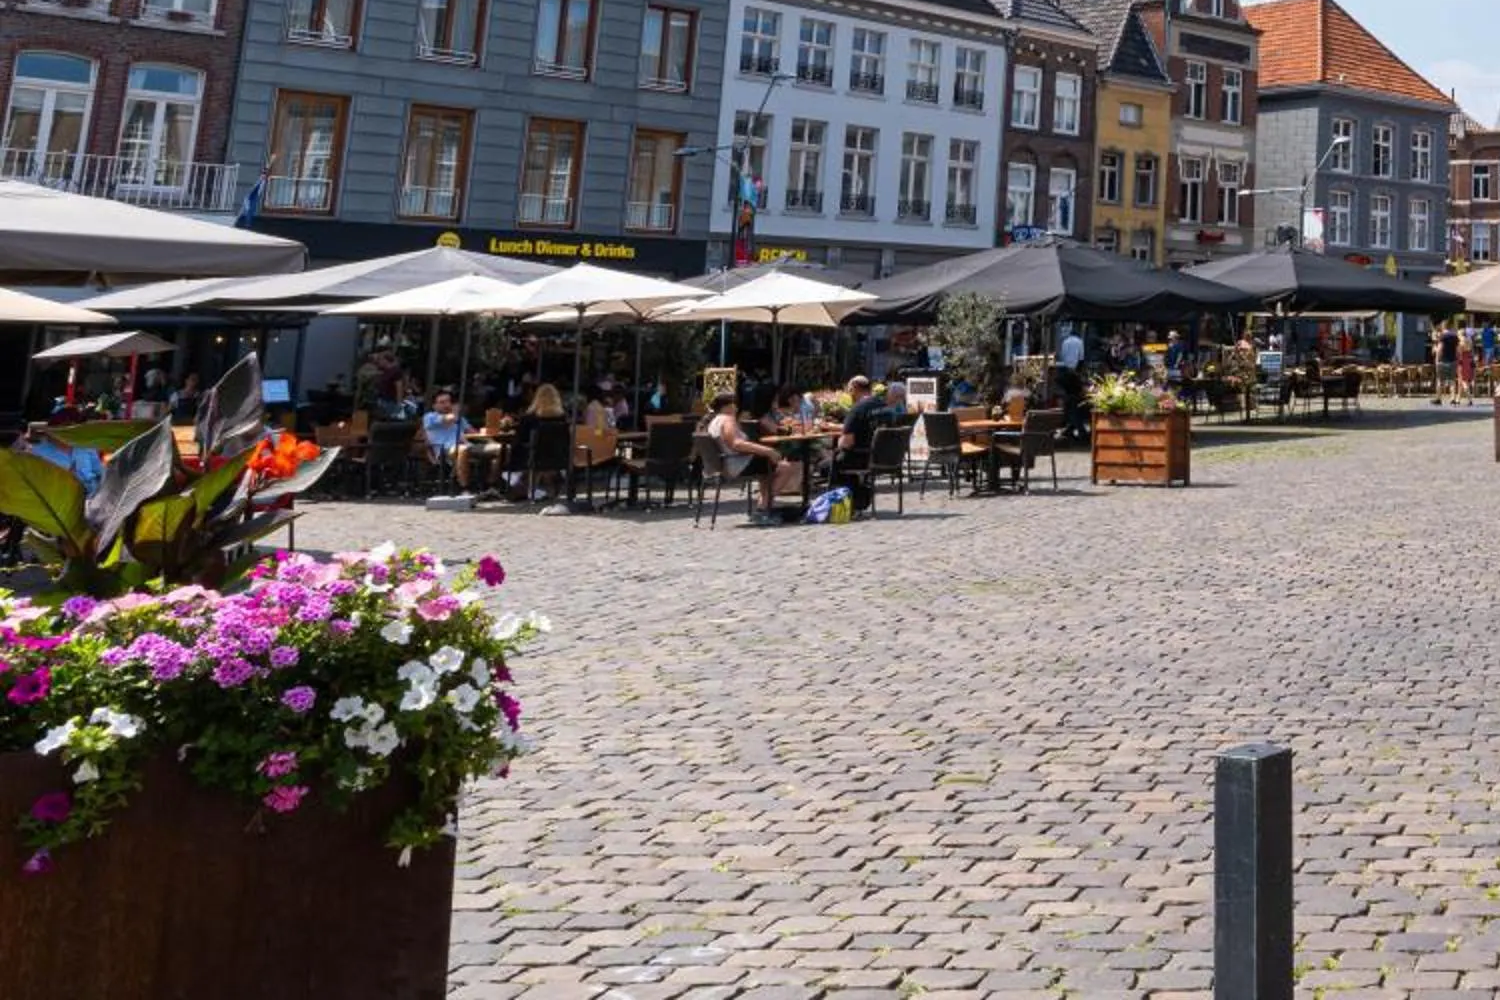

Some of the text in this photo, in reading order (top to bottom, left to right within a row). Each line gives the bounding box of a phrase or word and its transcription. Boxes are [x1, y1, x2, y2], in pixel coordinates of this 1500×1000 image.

[489, 238, 634, 258] Lunch Dinner & Drinks
